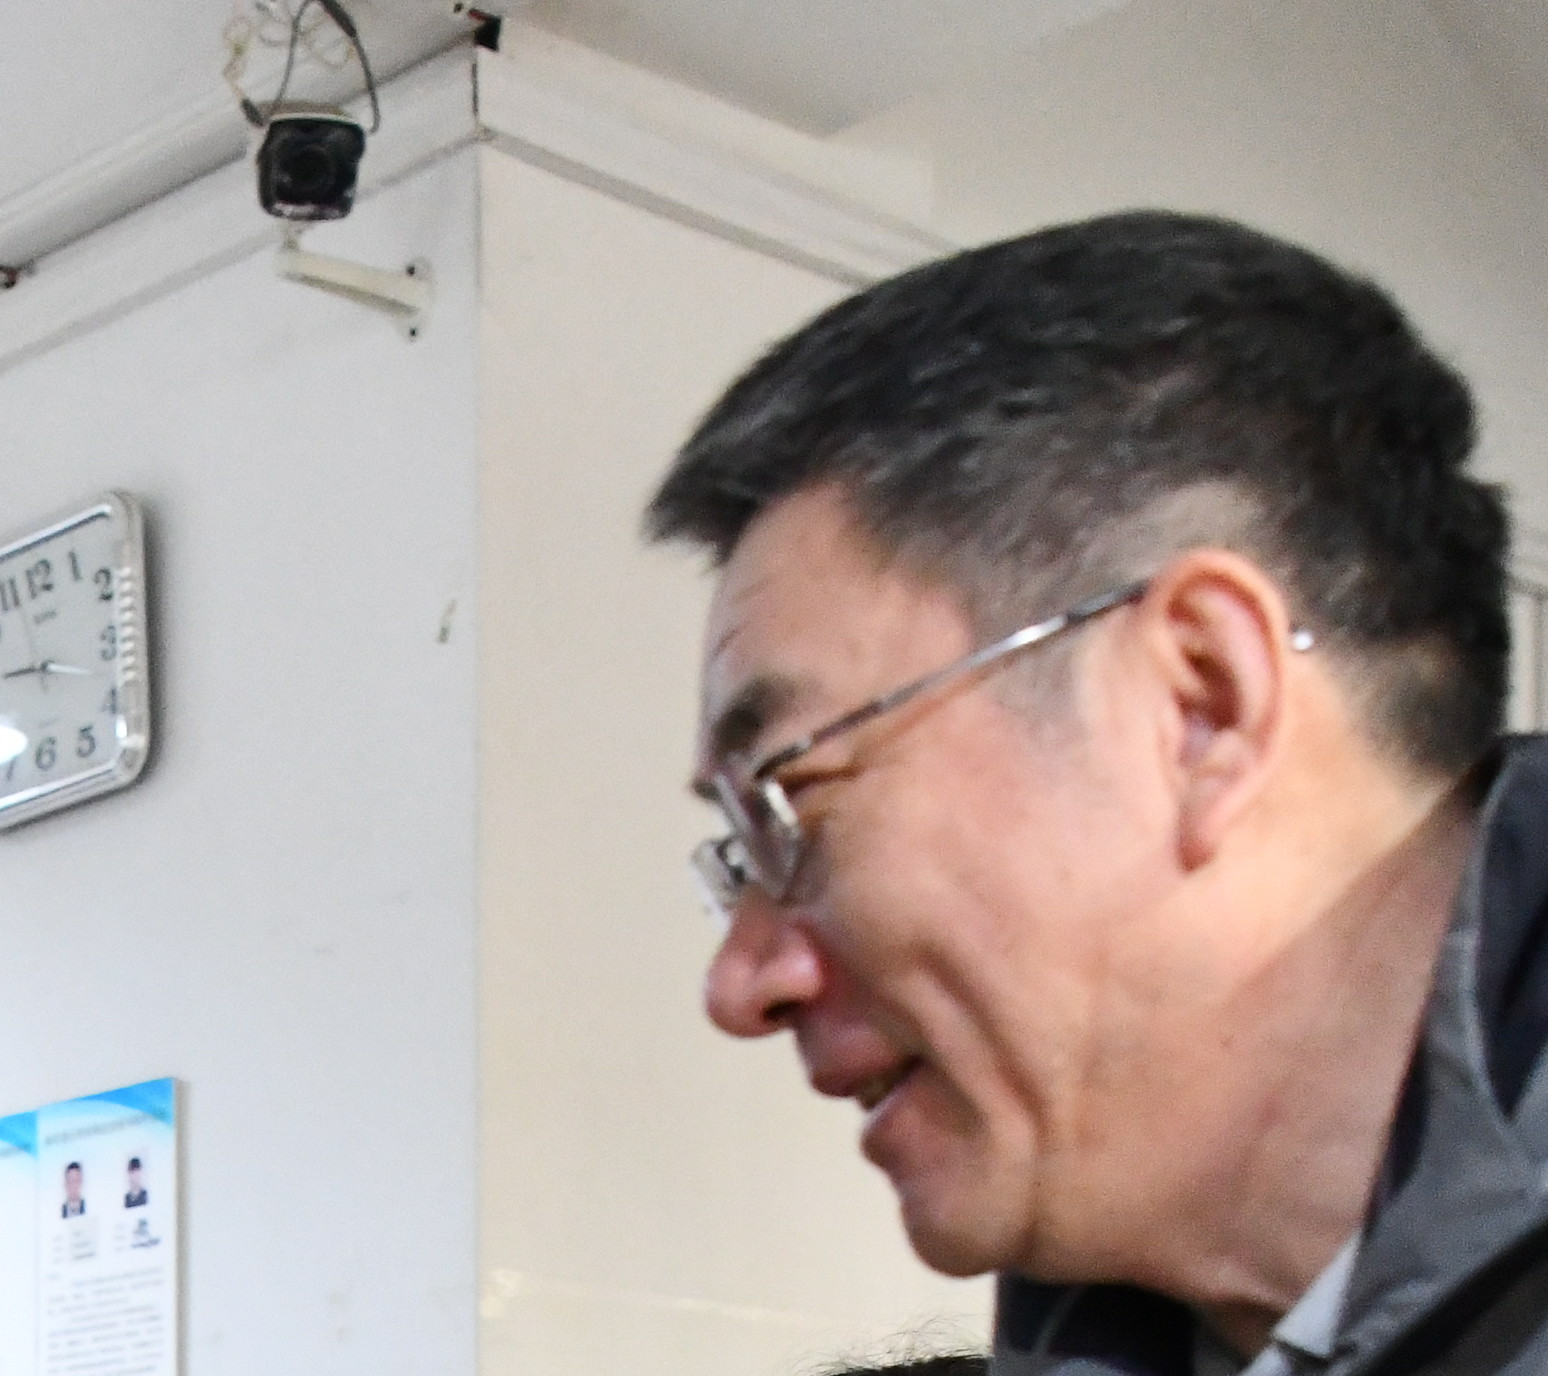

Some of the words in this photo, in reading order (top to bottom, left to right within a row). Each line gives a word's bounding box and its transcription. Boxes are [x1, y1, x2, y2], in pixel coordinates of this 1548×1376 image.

[25, 558, 54, 600] 12
[68, 550, 82, 582] 1
[93, 567, 114, 602] 2
[100, 625, 117, 662] 3
[102, 688, 118, 715] 4
[35, 736, 56, 771] 6
[76, 725, 96, 759] 5
